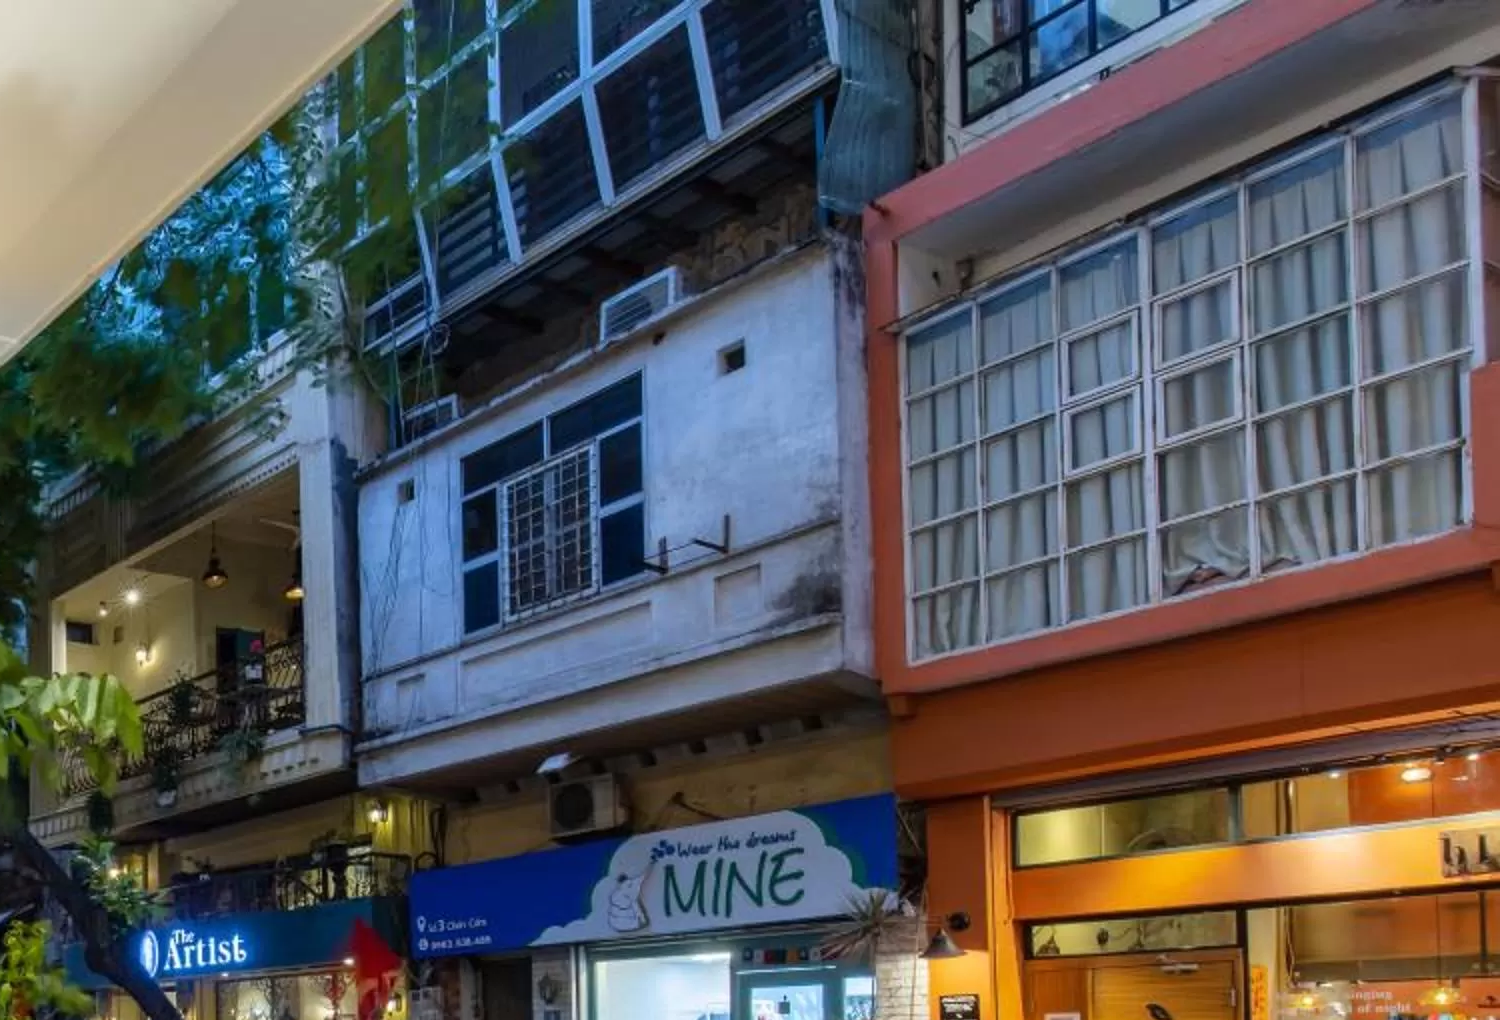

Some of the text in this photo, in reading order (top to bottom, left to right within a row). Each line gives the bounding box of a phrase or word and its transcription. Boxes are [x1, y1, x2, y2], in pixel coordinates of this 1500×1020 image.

[663, 847, 804, 918] MINE
[163, 934, 247, 971] Artist
[171, 928, 195, 945] The
